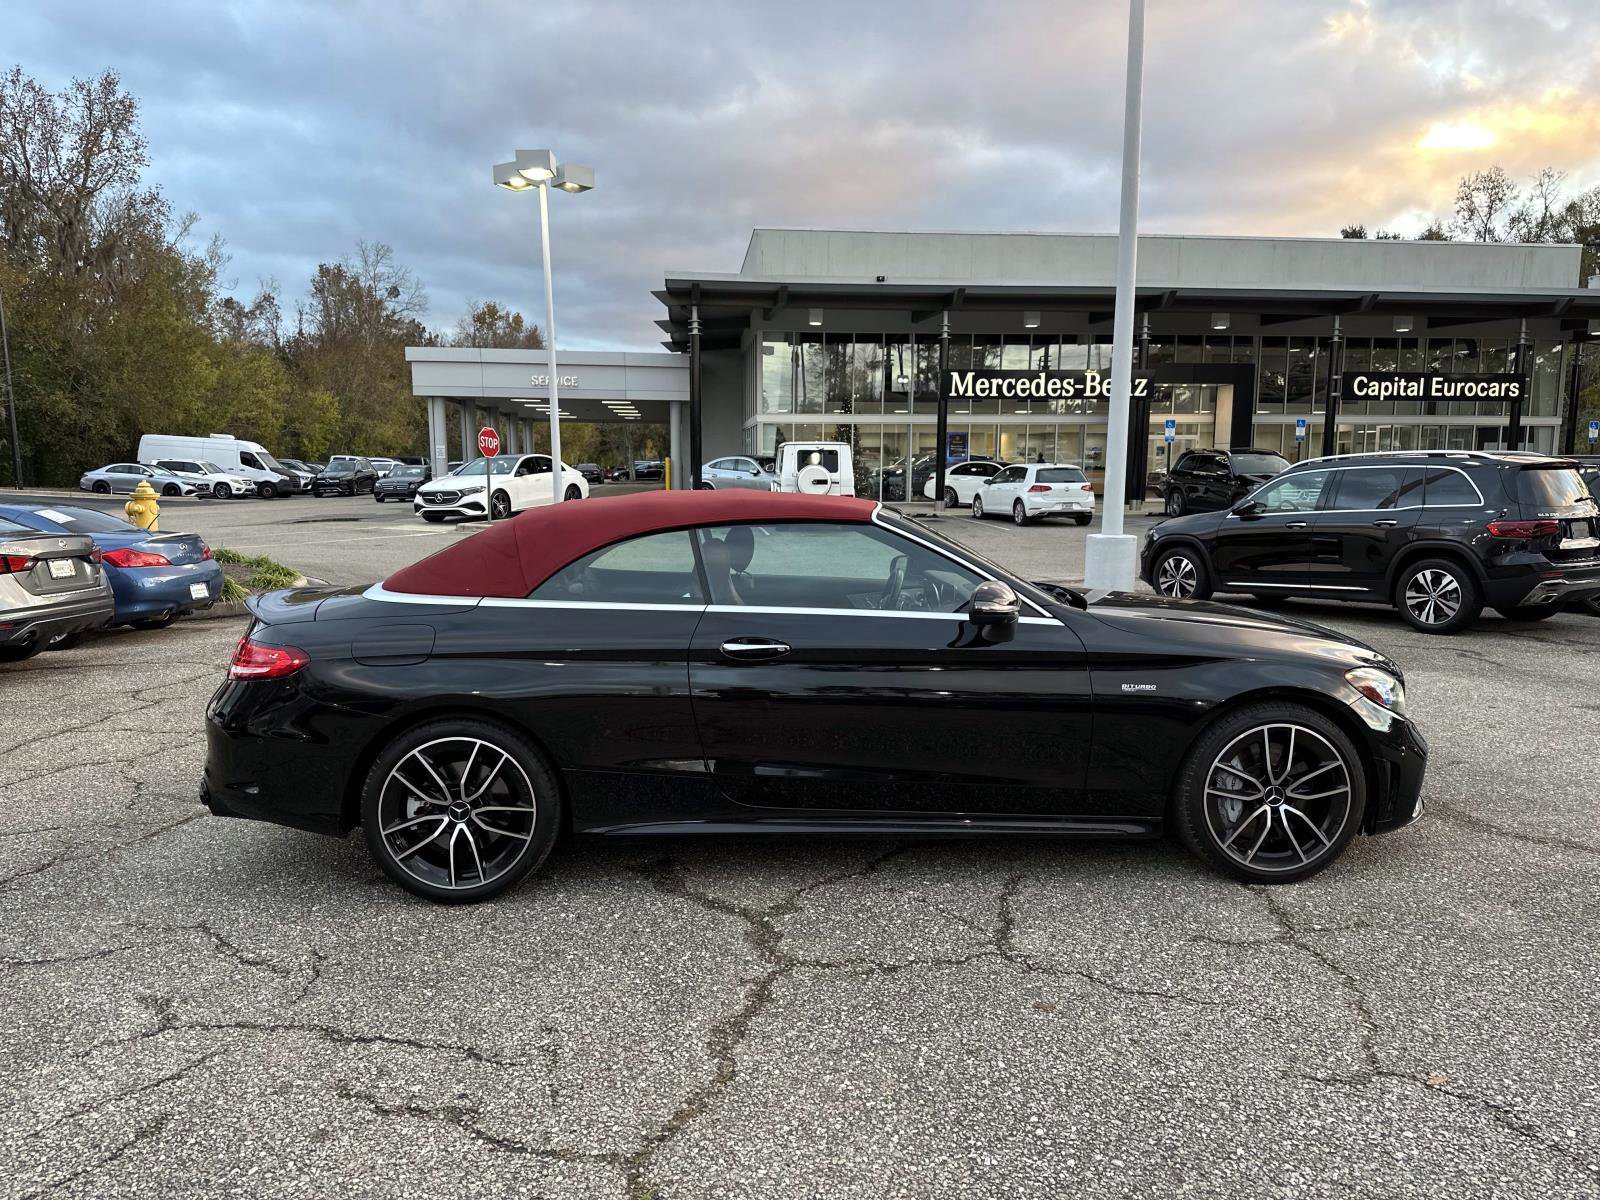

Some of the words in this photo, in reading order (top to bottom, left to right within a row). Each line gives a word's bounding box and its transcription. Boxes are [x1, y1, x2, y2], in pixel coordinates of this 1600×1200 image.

[531, 375, 578, 386] SEICE
[949, 371, 1148, 397] Mercedes-Bez
[1353, 376, 1425, 401] Capital
[1431, 377, 1520, 397] Eurocars
[480, 436, 498, 450] STOP
